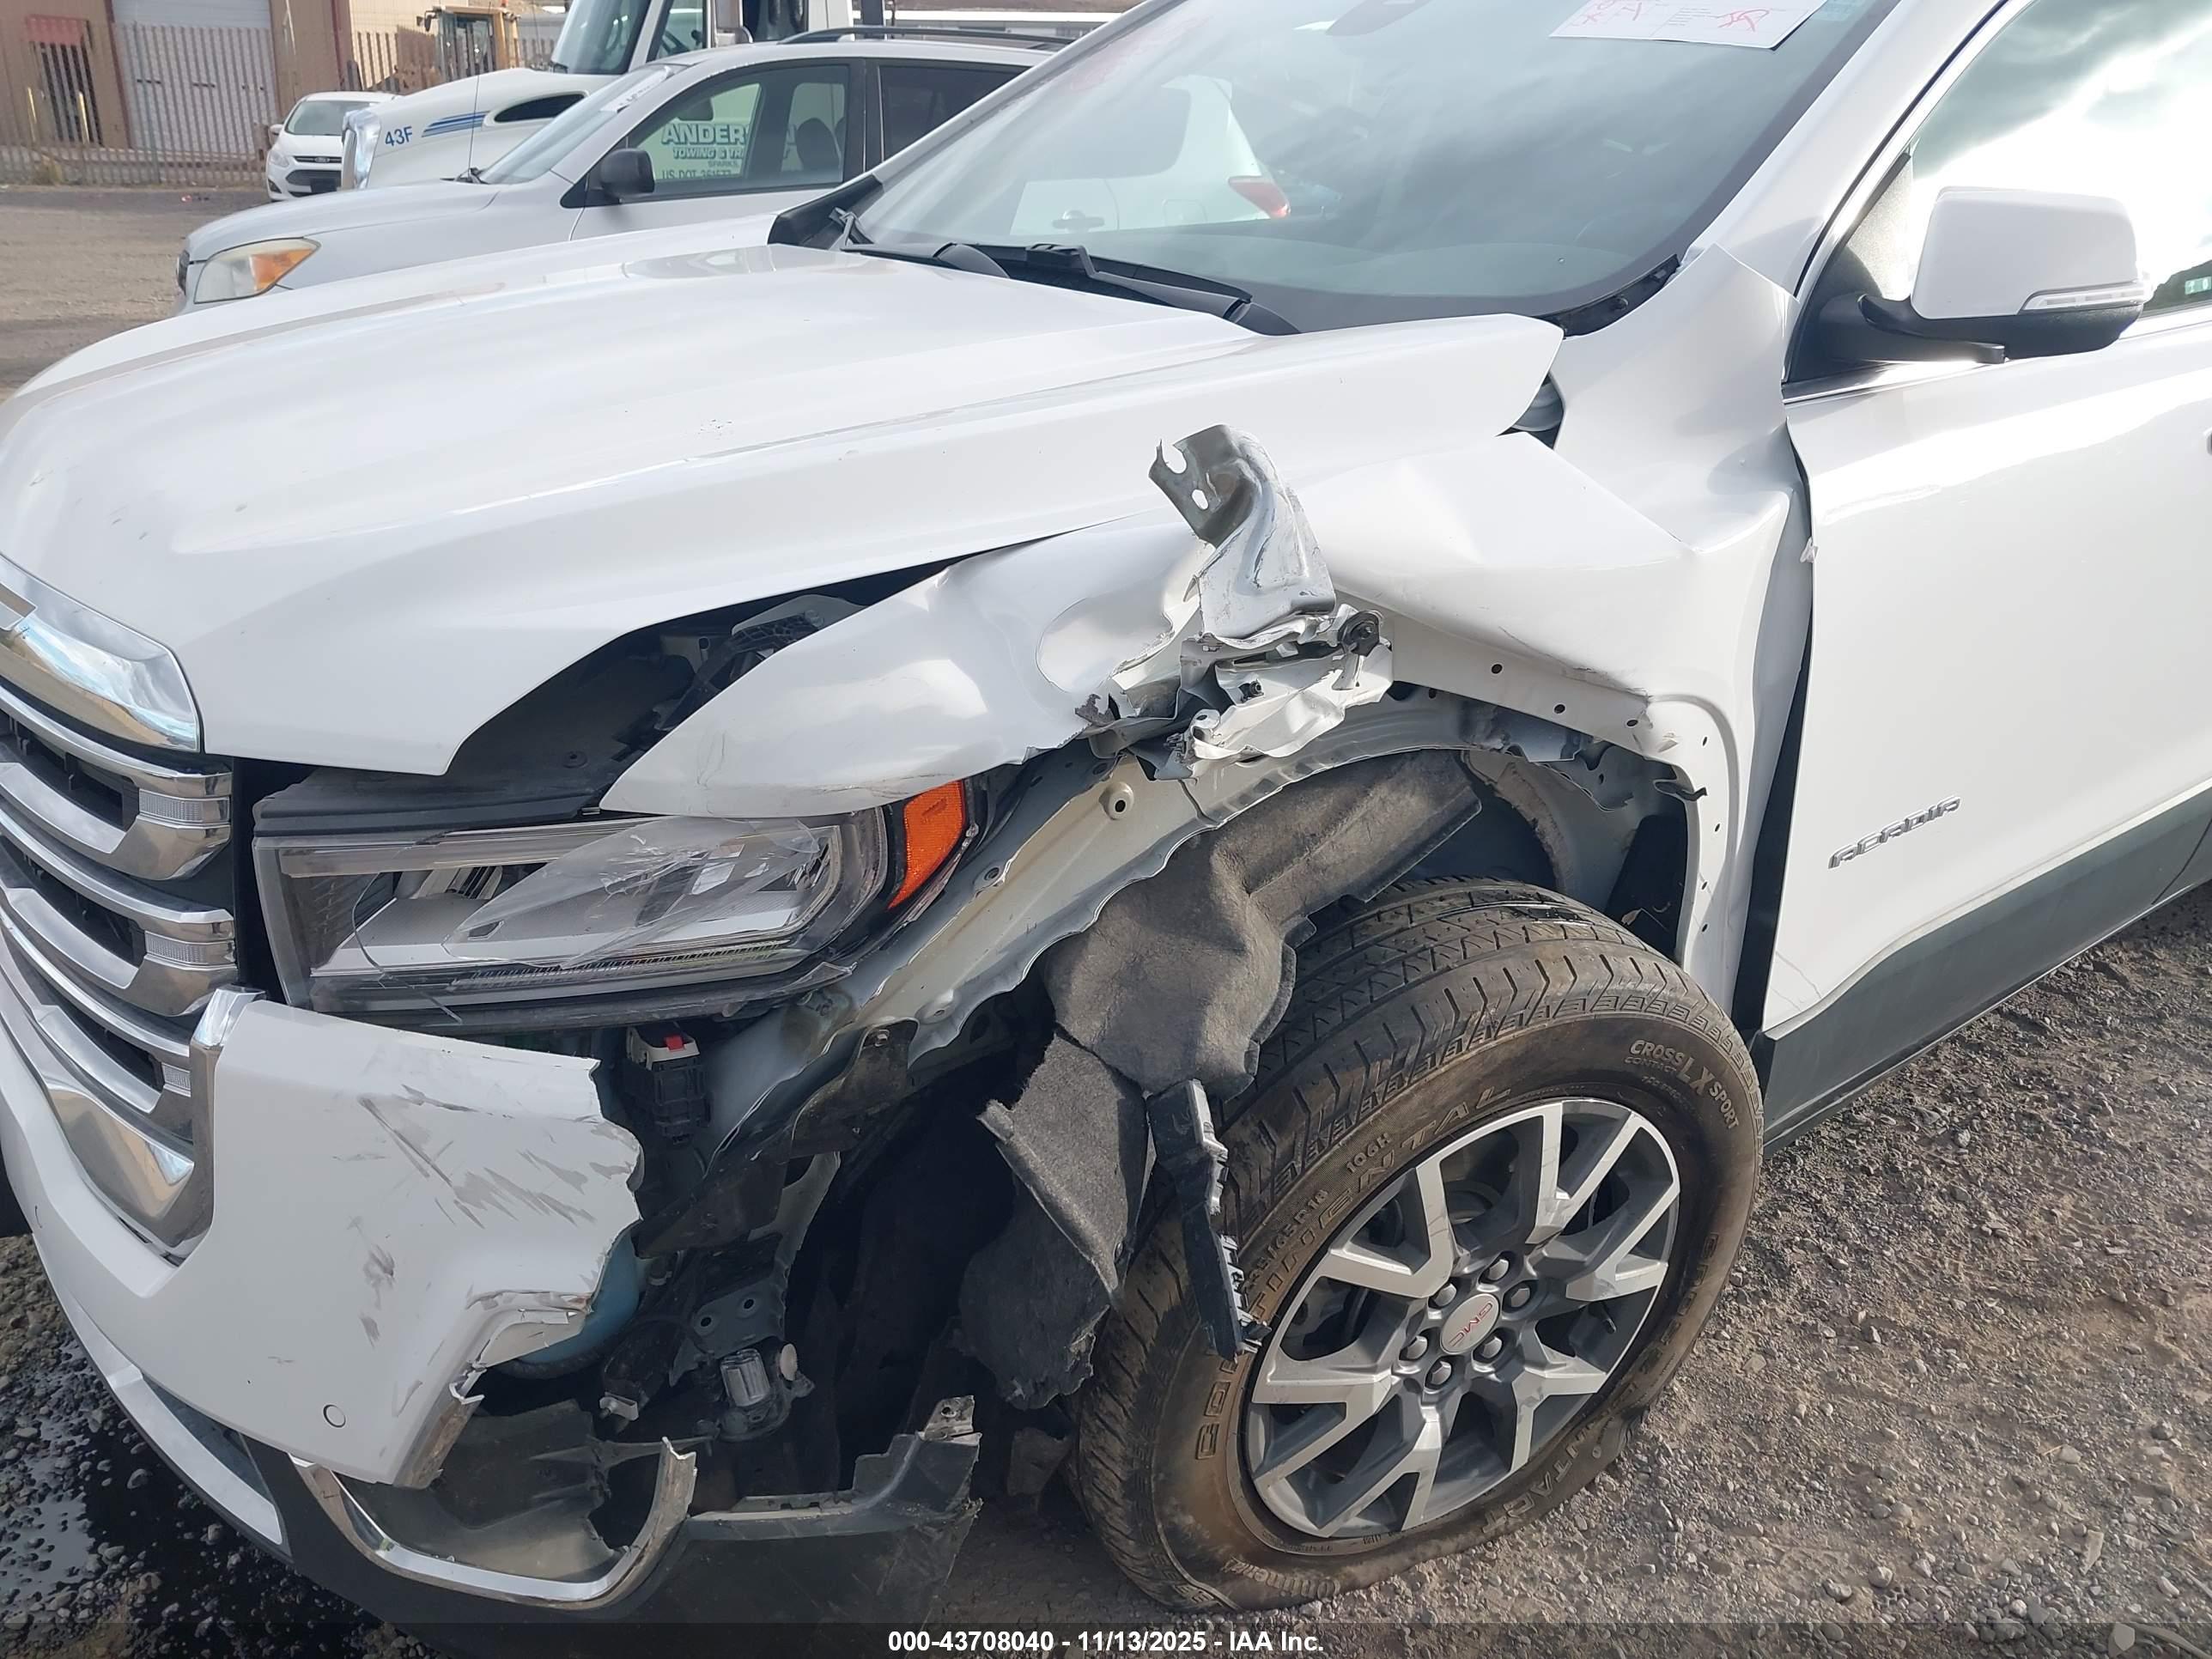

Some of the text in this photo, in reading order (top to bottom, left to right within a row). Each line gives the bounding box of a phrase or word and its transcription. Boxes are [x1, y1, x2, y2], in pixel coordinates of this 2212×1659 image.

[385, 125, 412, 146] 43F
[672, 147, 715, 160] TOWING
[1624, 1055, 1678, 1073] CONTACT
[1630, 1039, 1686, 1066] CROSS
[1708, 1081, 1740, 1130] SPORT
[1346, 1132, 1391, 1175] 106H
[1448, 1302, 1493, 1347] GMC
